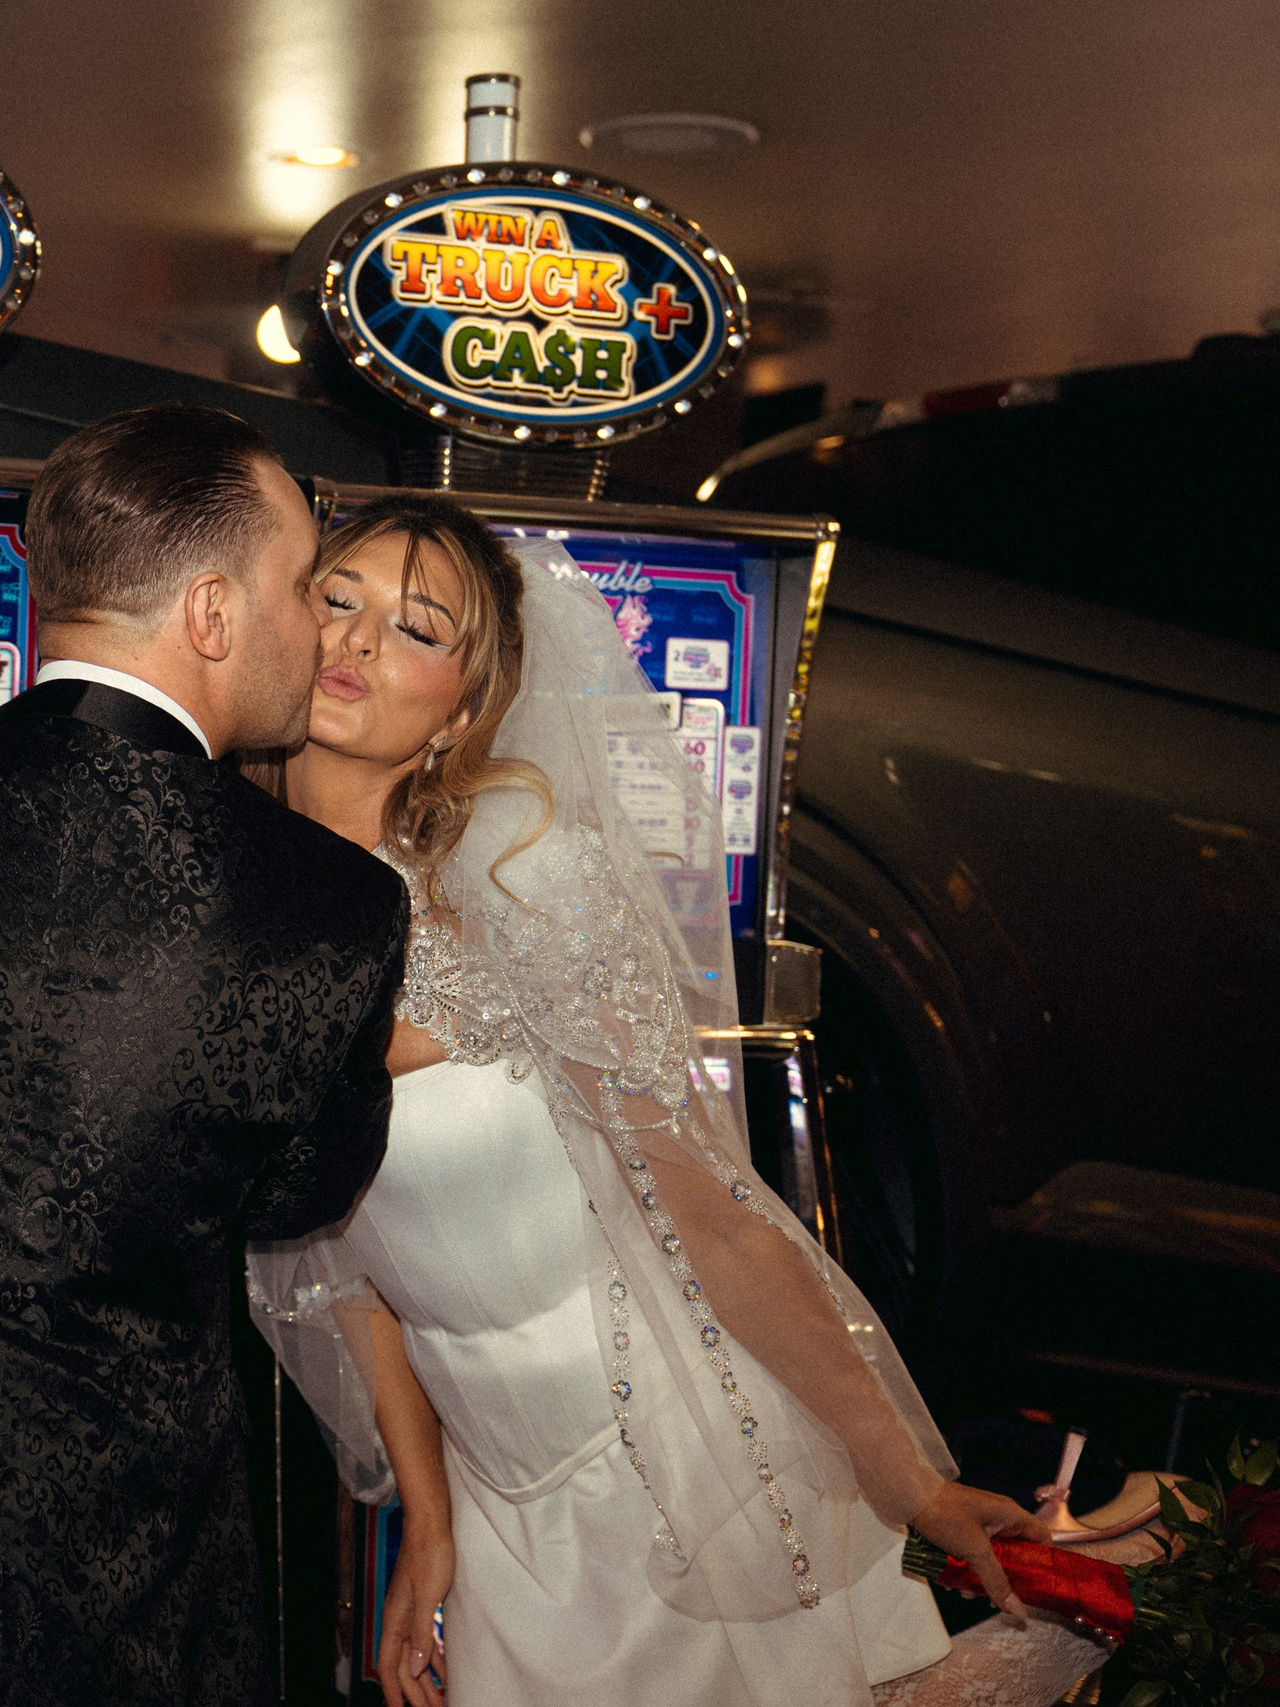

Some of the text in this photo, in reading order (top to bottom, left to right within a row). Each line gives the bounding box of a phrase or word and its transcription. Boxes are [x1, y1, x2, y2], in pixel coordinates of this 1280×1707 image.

[453, 209, 564, 250] WIN A
[391, 239, 623, 315] TRUCK
[451, 325, 627, 394] CA$H
